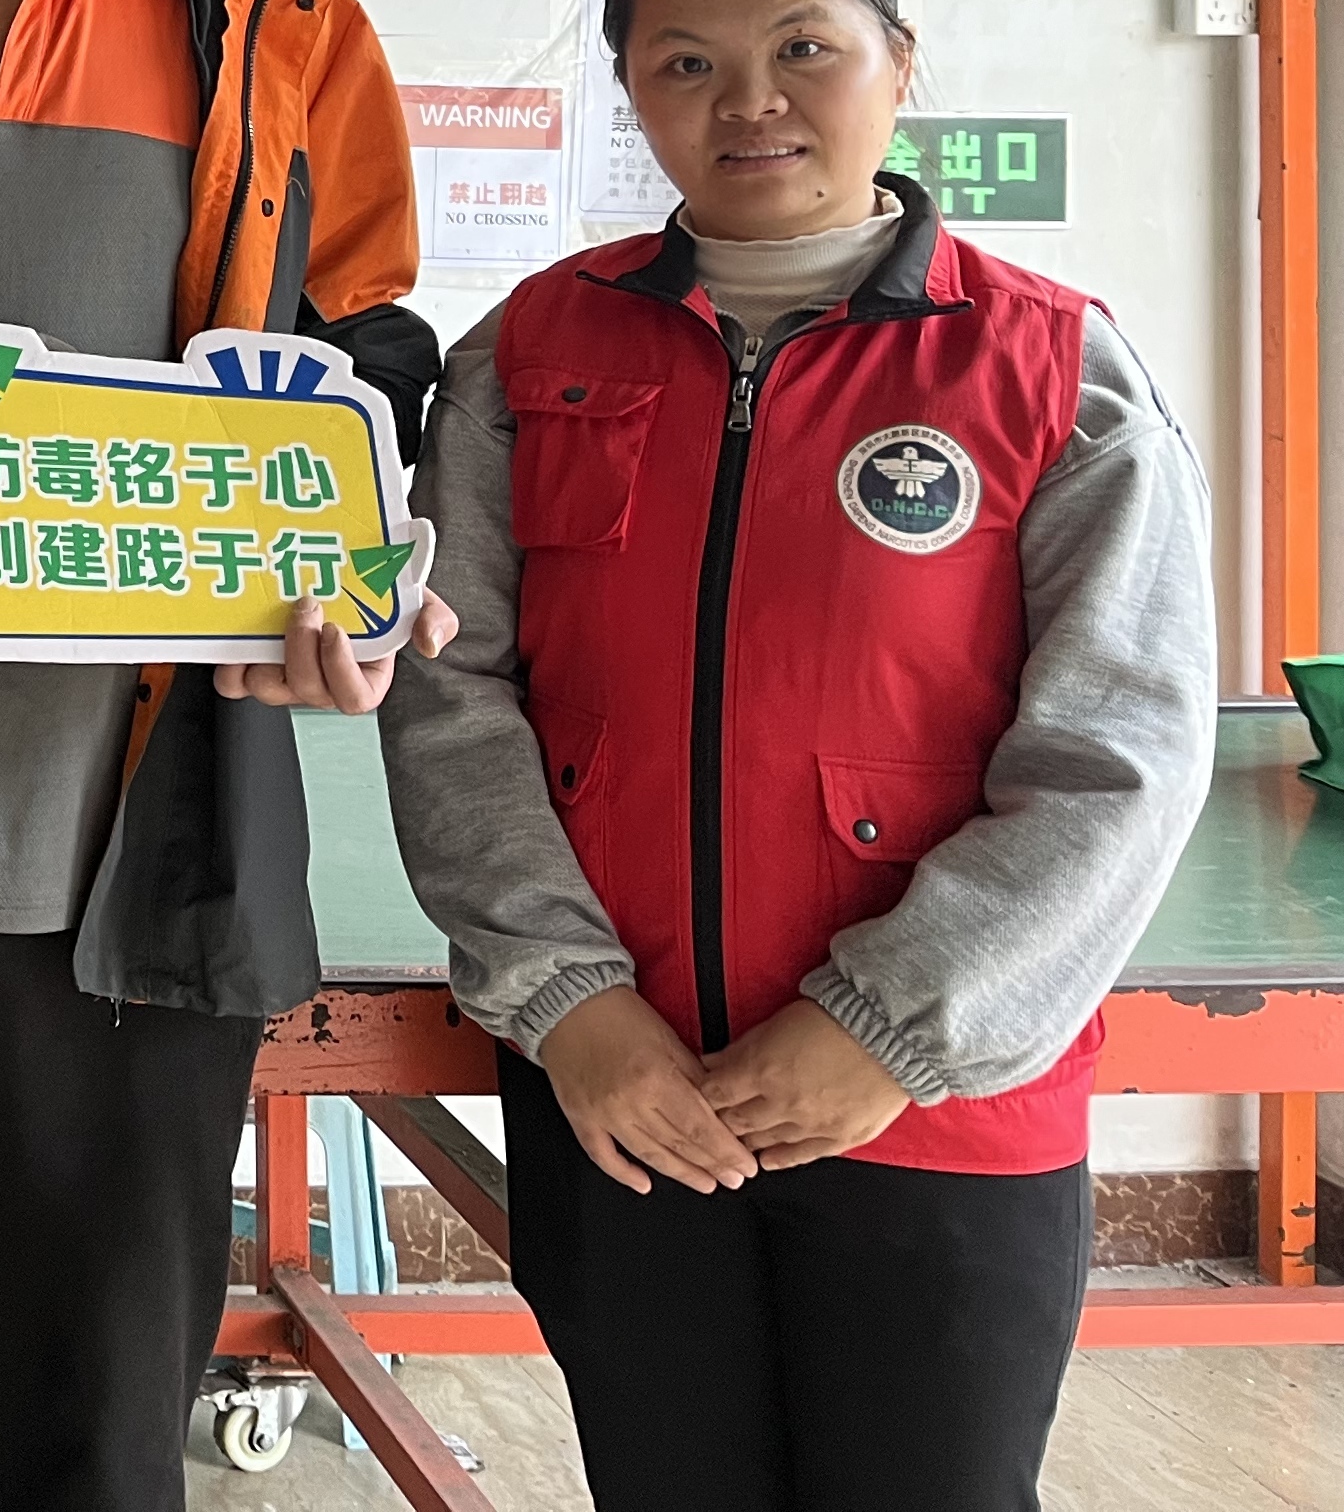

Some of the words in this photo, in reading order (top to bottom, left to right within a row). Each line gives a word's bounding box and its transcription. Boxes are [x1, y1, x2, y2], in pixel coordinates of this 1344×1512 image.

[419, 103, 552, 129] WARNING
[448, 182, 547, 206] 禁止翻越
[445, 212, 467, 225] NO
[474, 212, 549, 227] CROSSING
